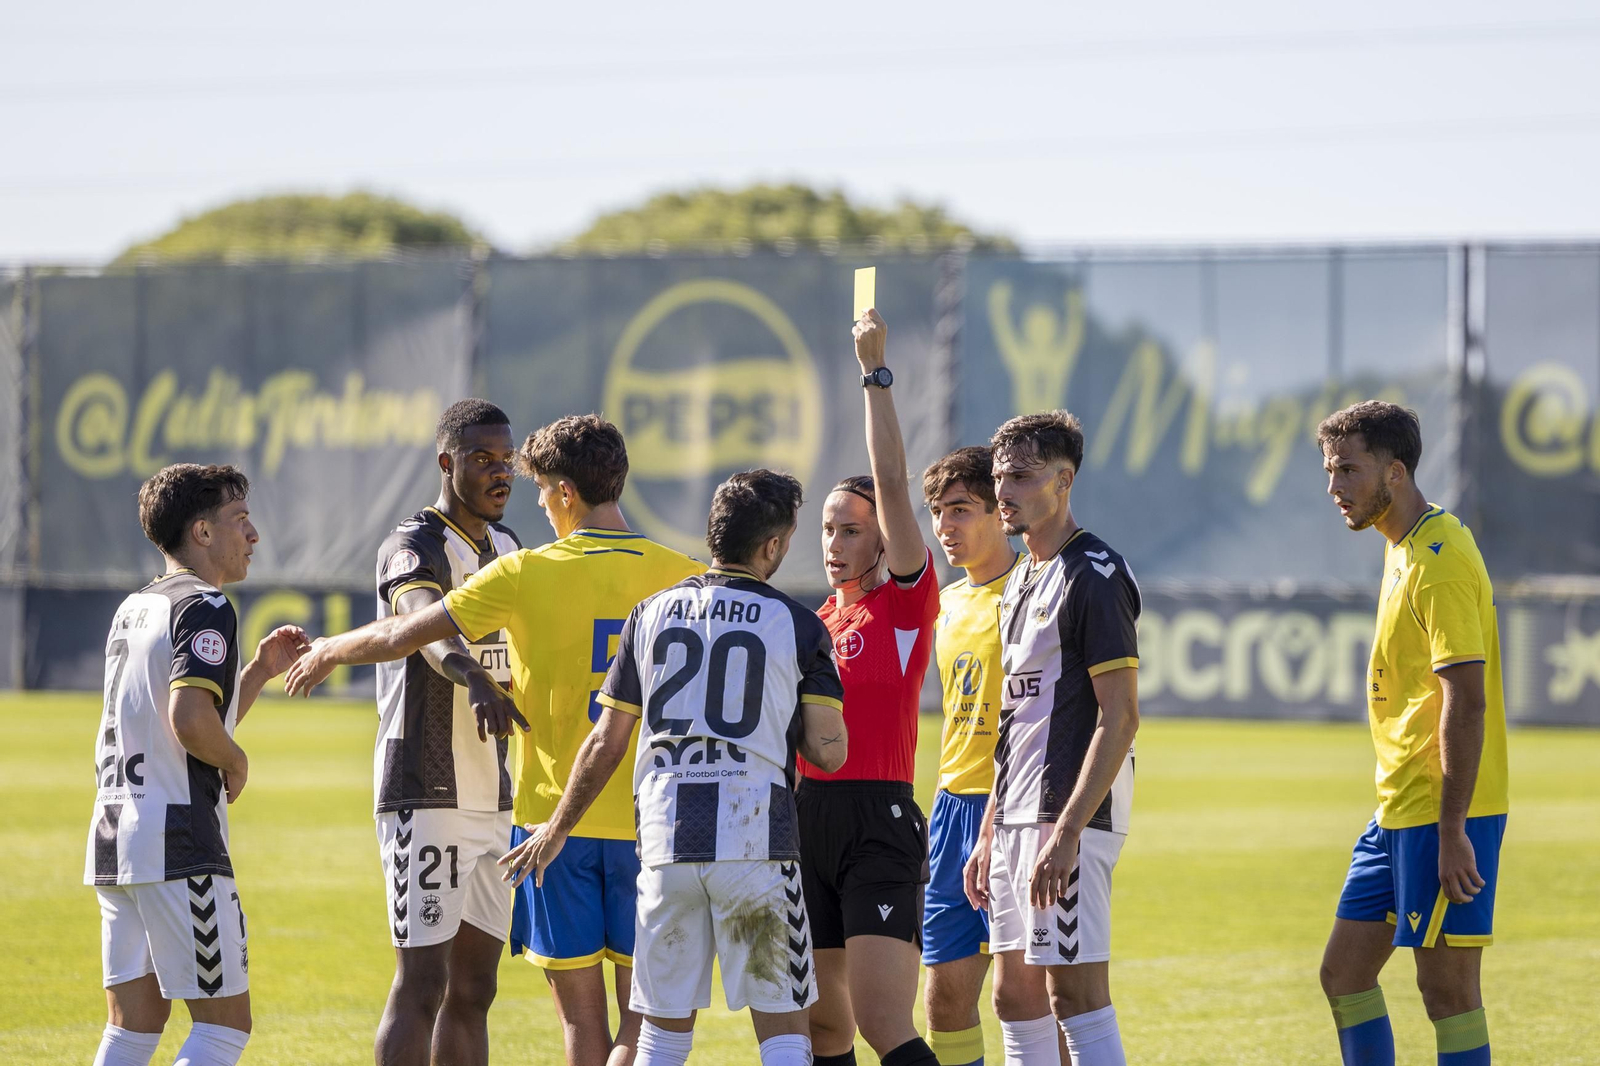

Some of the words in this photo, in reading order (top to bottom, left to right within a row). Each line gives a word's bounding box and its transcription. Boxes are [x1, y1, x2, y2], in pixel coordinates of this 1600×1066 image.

[622, 390, 801, 443] PEPSI
[648, 626, 767, 739] 20
[686, 769, 720, 778] Football
[721, 769, 749, 777] Center
[419, 845, 459, 890] 21
